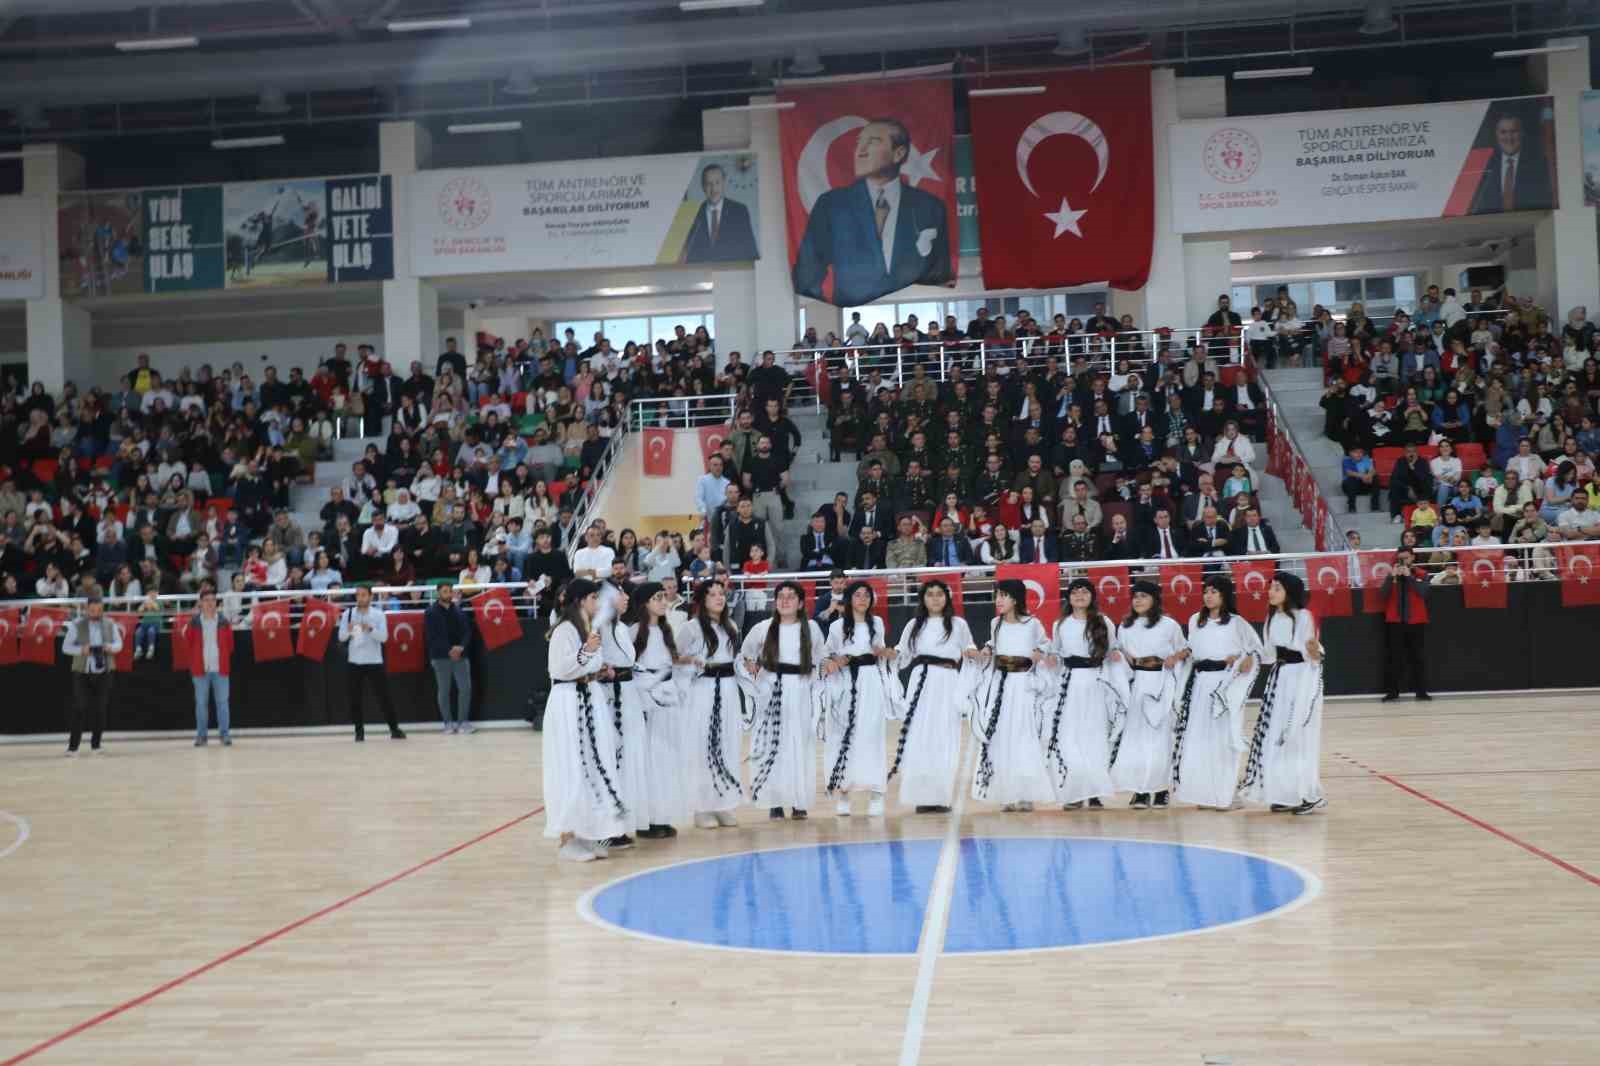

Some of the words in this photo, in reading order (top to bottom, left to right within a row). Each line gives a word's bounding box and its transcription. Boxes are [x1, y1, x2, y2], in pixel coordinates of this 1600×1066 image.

[1298, 126, 1330, 140] TÜM
[1333, 121, 1408, 138] ANTRENÖR
[1411, 120, 1432, 134] VE
[1303, 135, 1427, 154] SPORCULARIMIZA
[1296, 153, 1364, 167] BAŞARILAR
[1366, 148, 1435, 162] DİLİYORUM
[526, 177, 554, 191] TÜM
[557, 173, 628, 190] ANTRENÖR
[629, 173, 647, 186] VE
[529, 187, 643, 204] SPORCULARIMIZA
[522, 204, 585, 217] BAŞARILAR
[587, 199, 651, 213] DİLİYORUM
[331, 214, 371, 240] YETE
